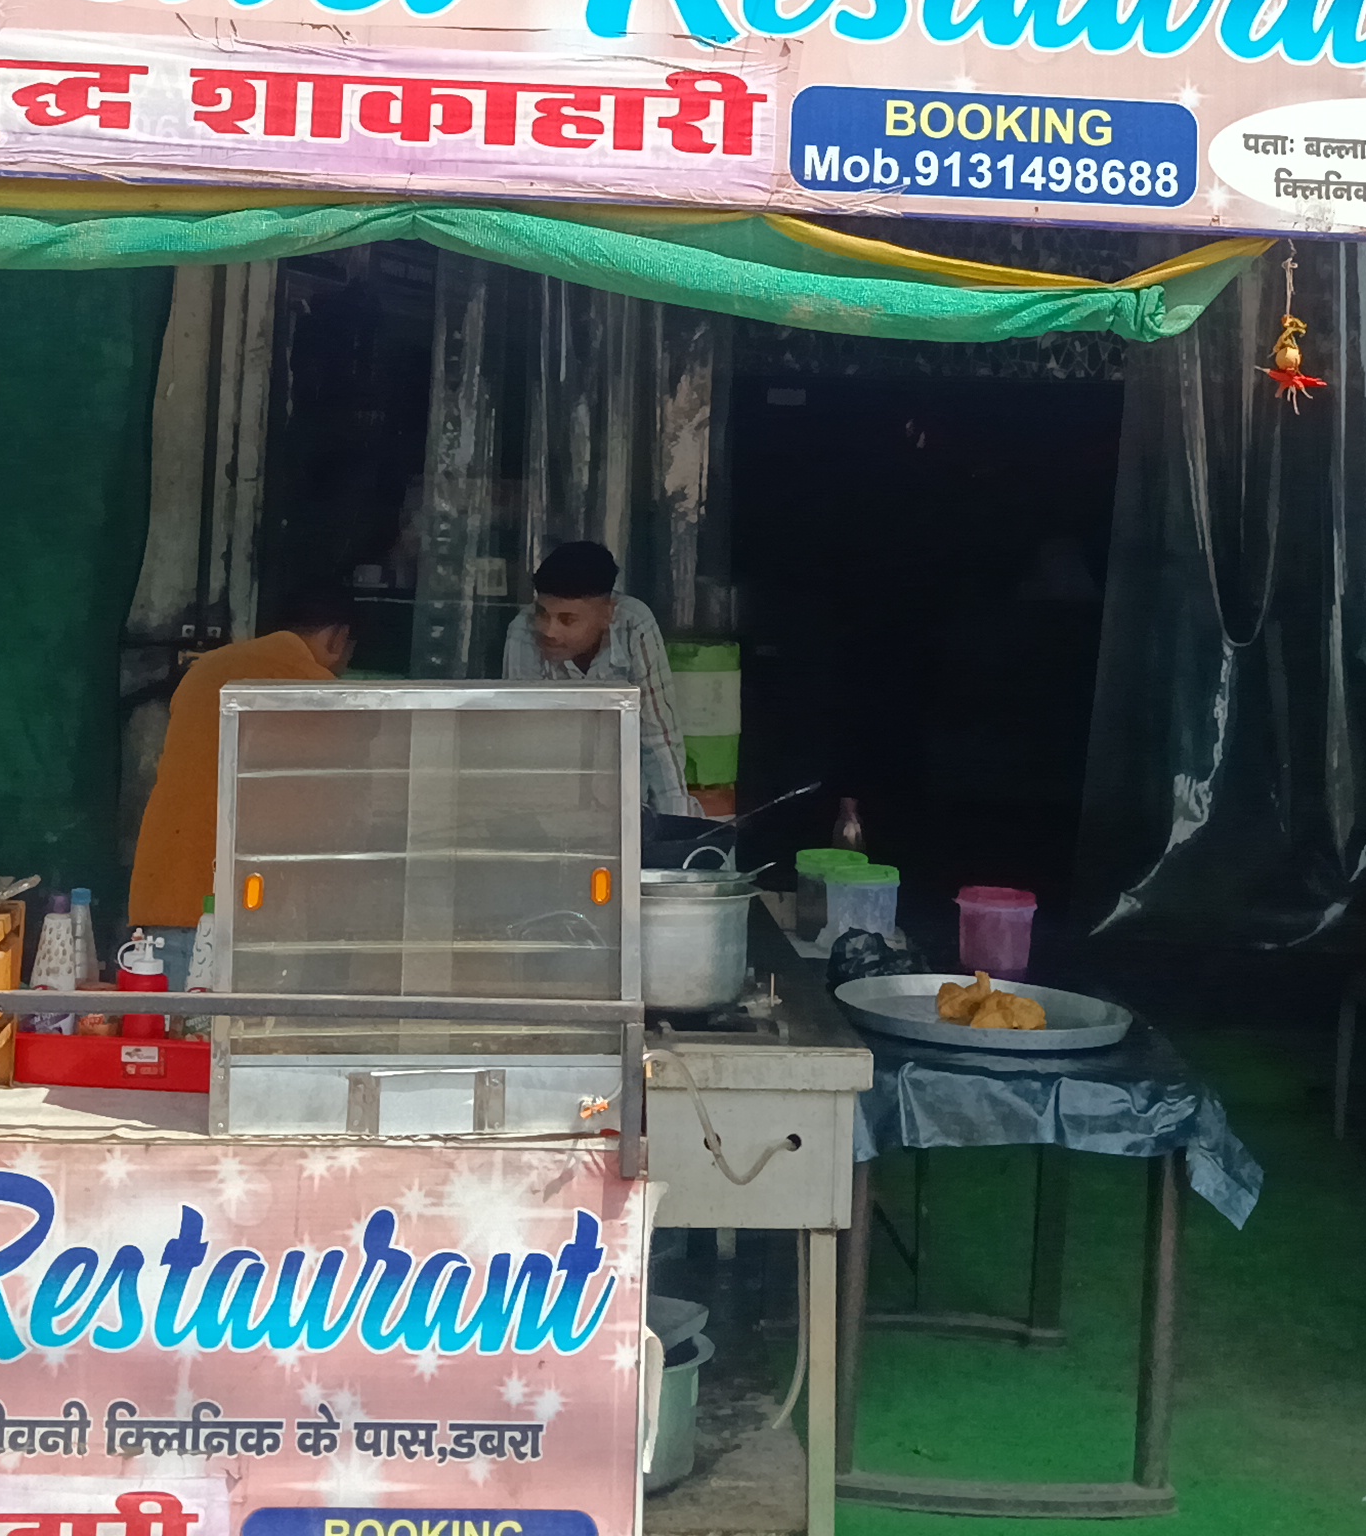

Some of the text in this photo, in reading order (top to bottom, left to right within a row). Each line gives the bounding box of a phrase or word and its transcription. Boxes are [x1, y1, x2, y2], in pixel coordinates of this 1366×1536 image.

[189, 69, 768, 158] शाकाहारी
[885, 98, 1113, 147] BOOKING
[802, 144, 1180, 199] Mob.9131498688
[105, 1400, 283, 1457] क्लिनिक
[296, 1403, 340, 1457] के
